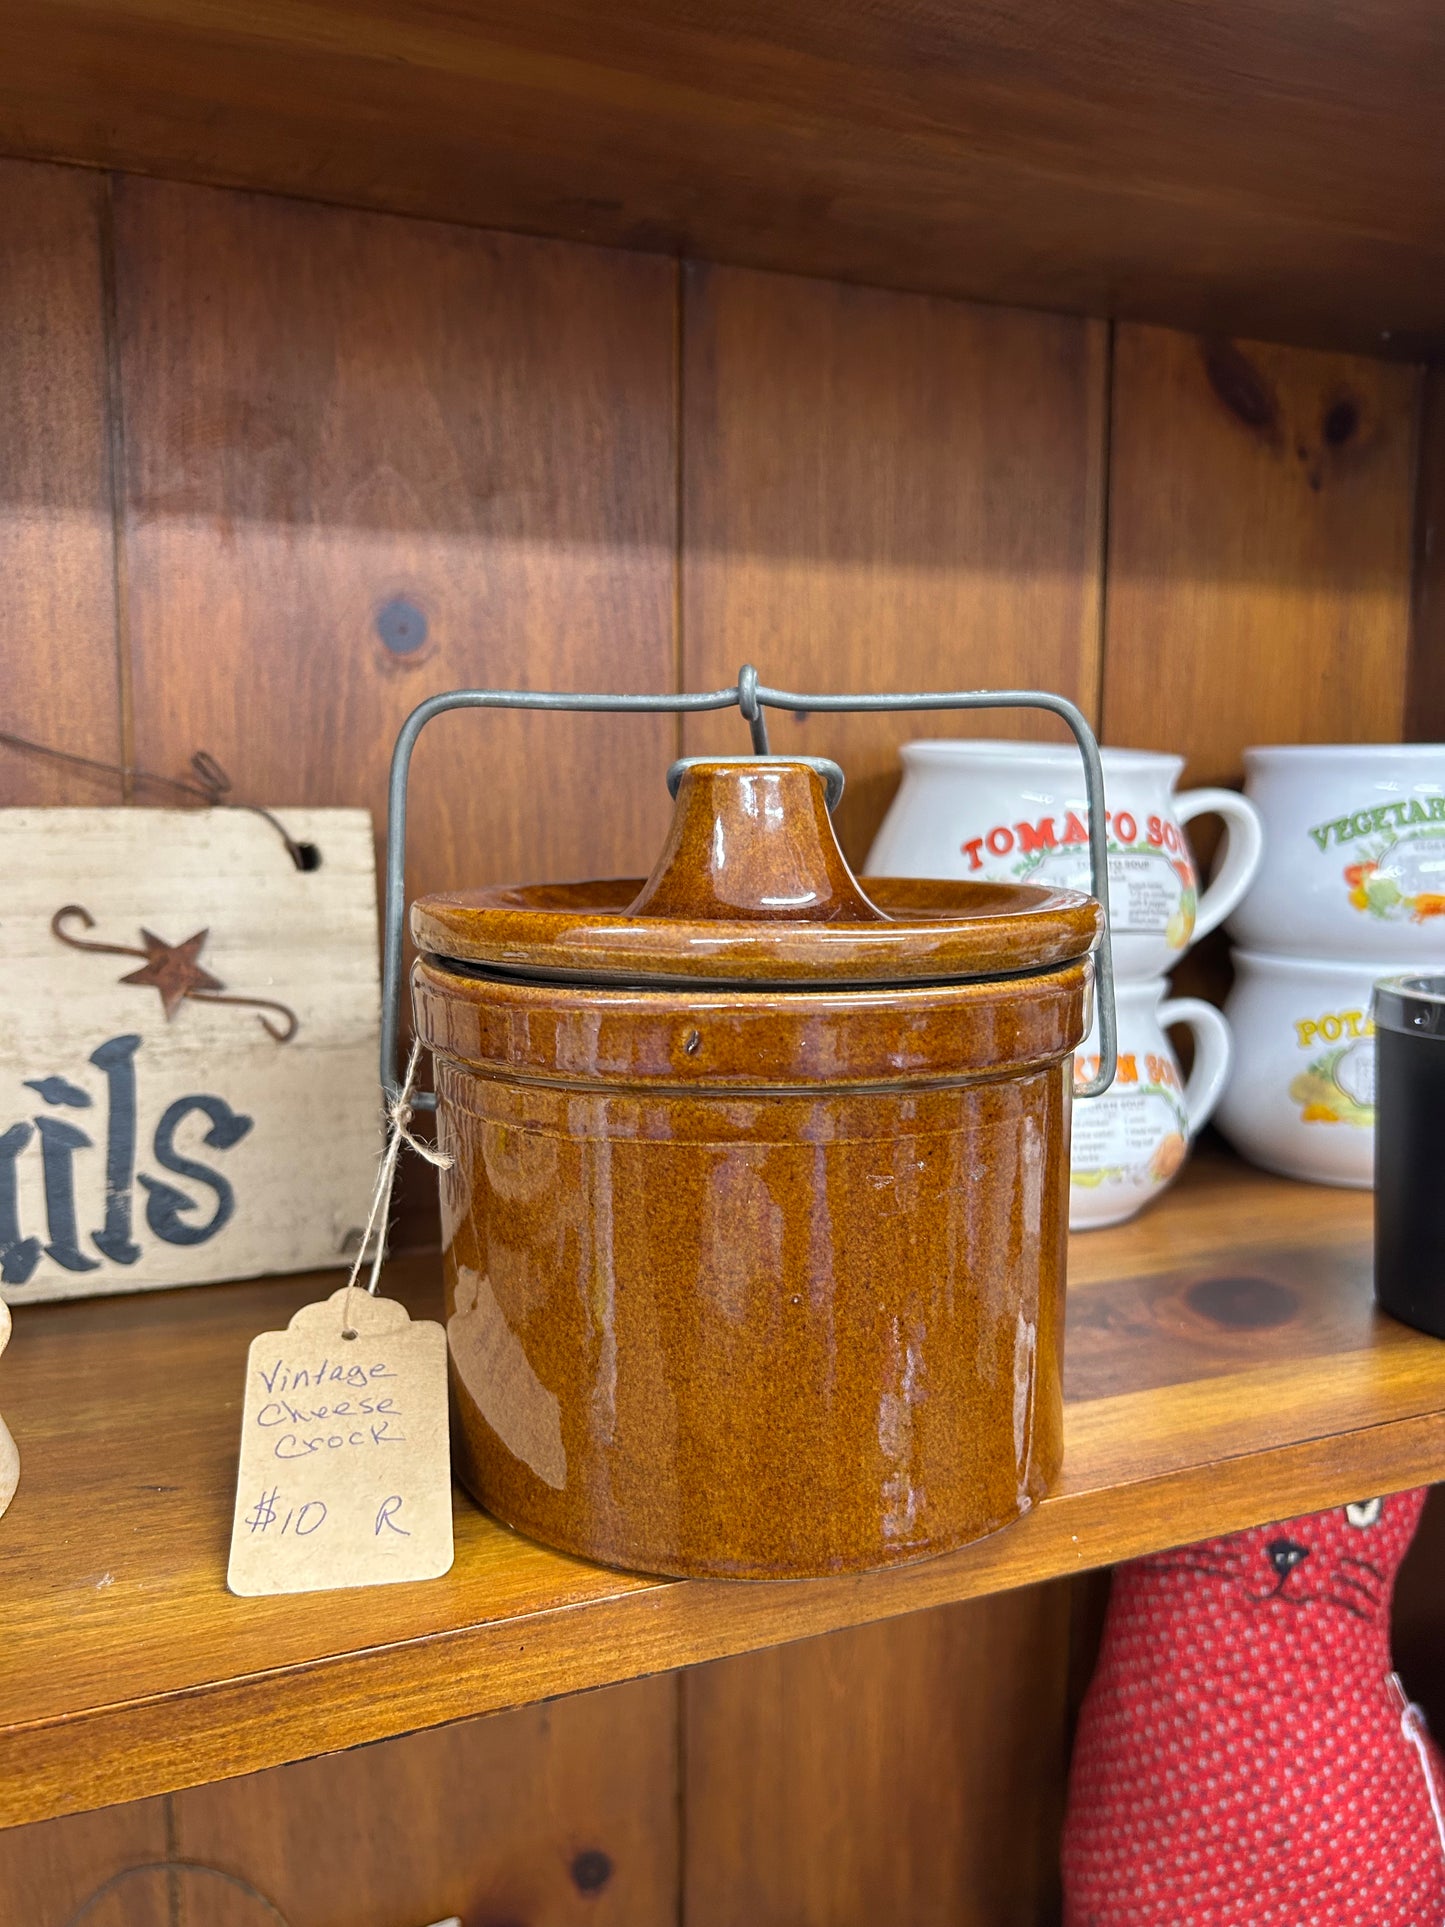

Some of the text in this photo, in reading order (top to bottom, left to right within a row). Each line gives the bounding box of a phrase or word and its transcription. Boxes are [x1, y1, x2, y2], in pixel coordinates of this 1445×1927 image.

[961, 810, 1138, 872] TOMAO
[258, 1359, 398, 1394] Vintage
[256, 1398, 402, 1428] Cheese
[245, 1486, 411, 1537] $10 R
